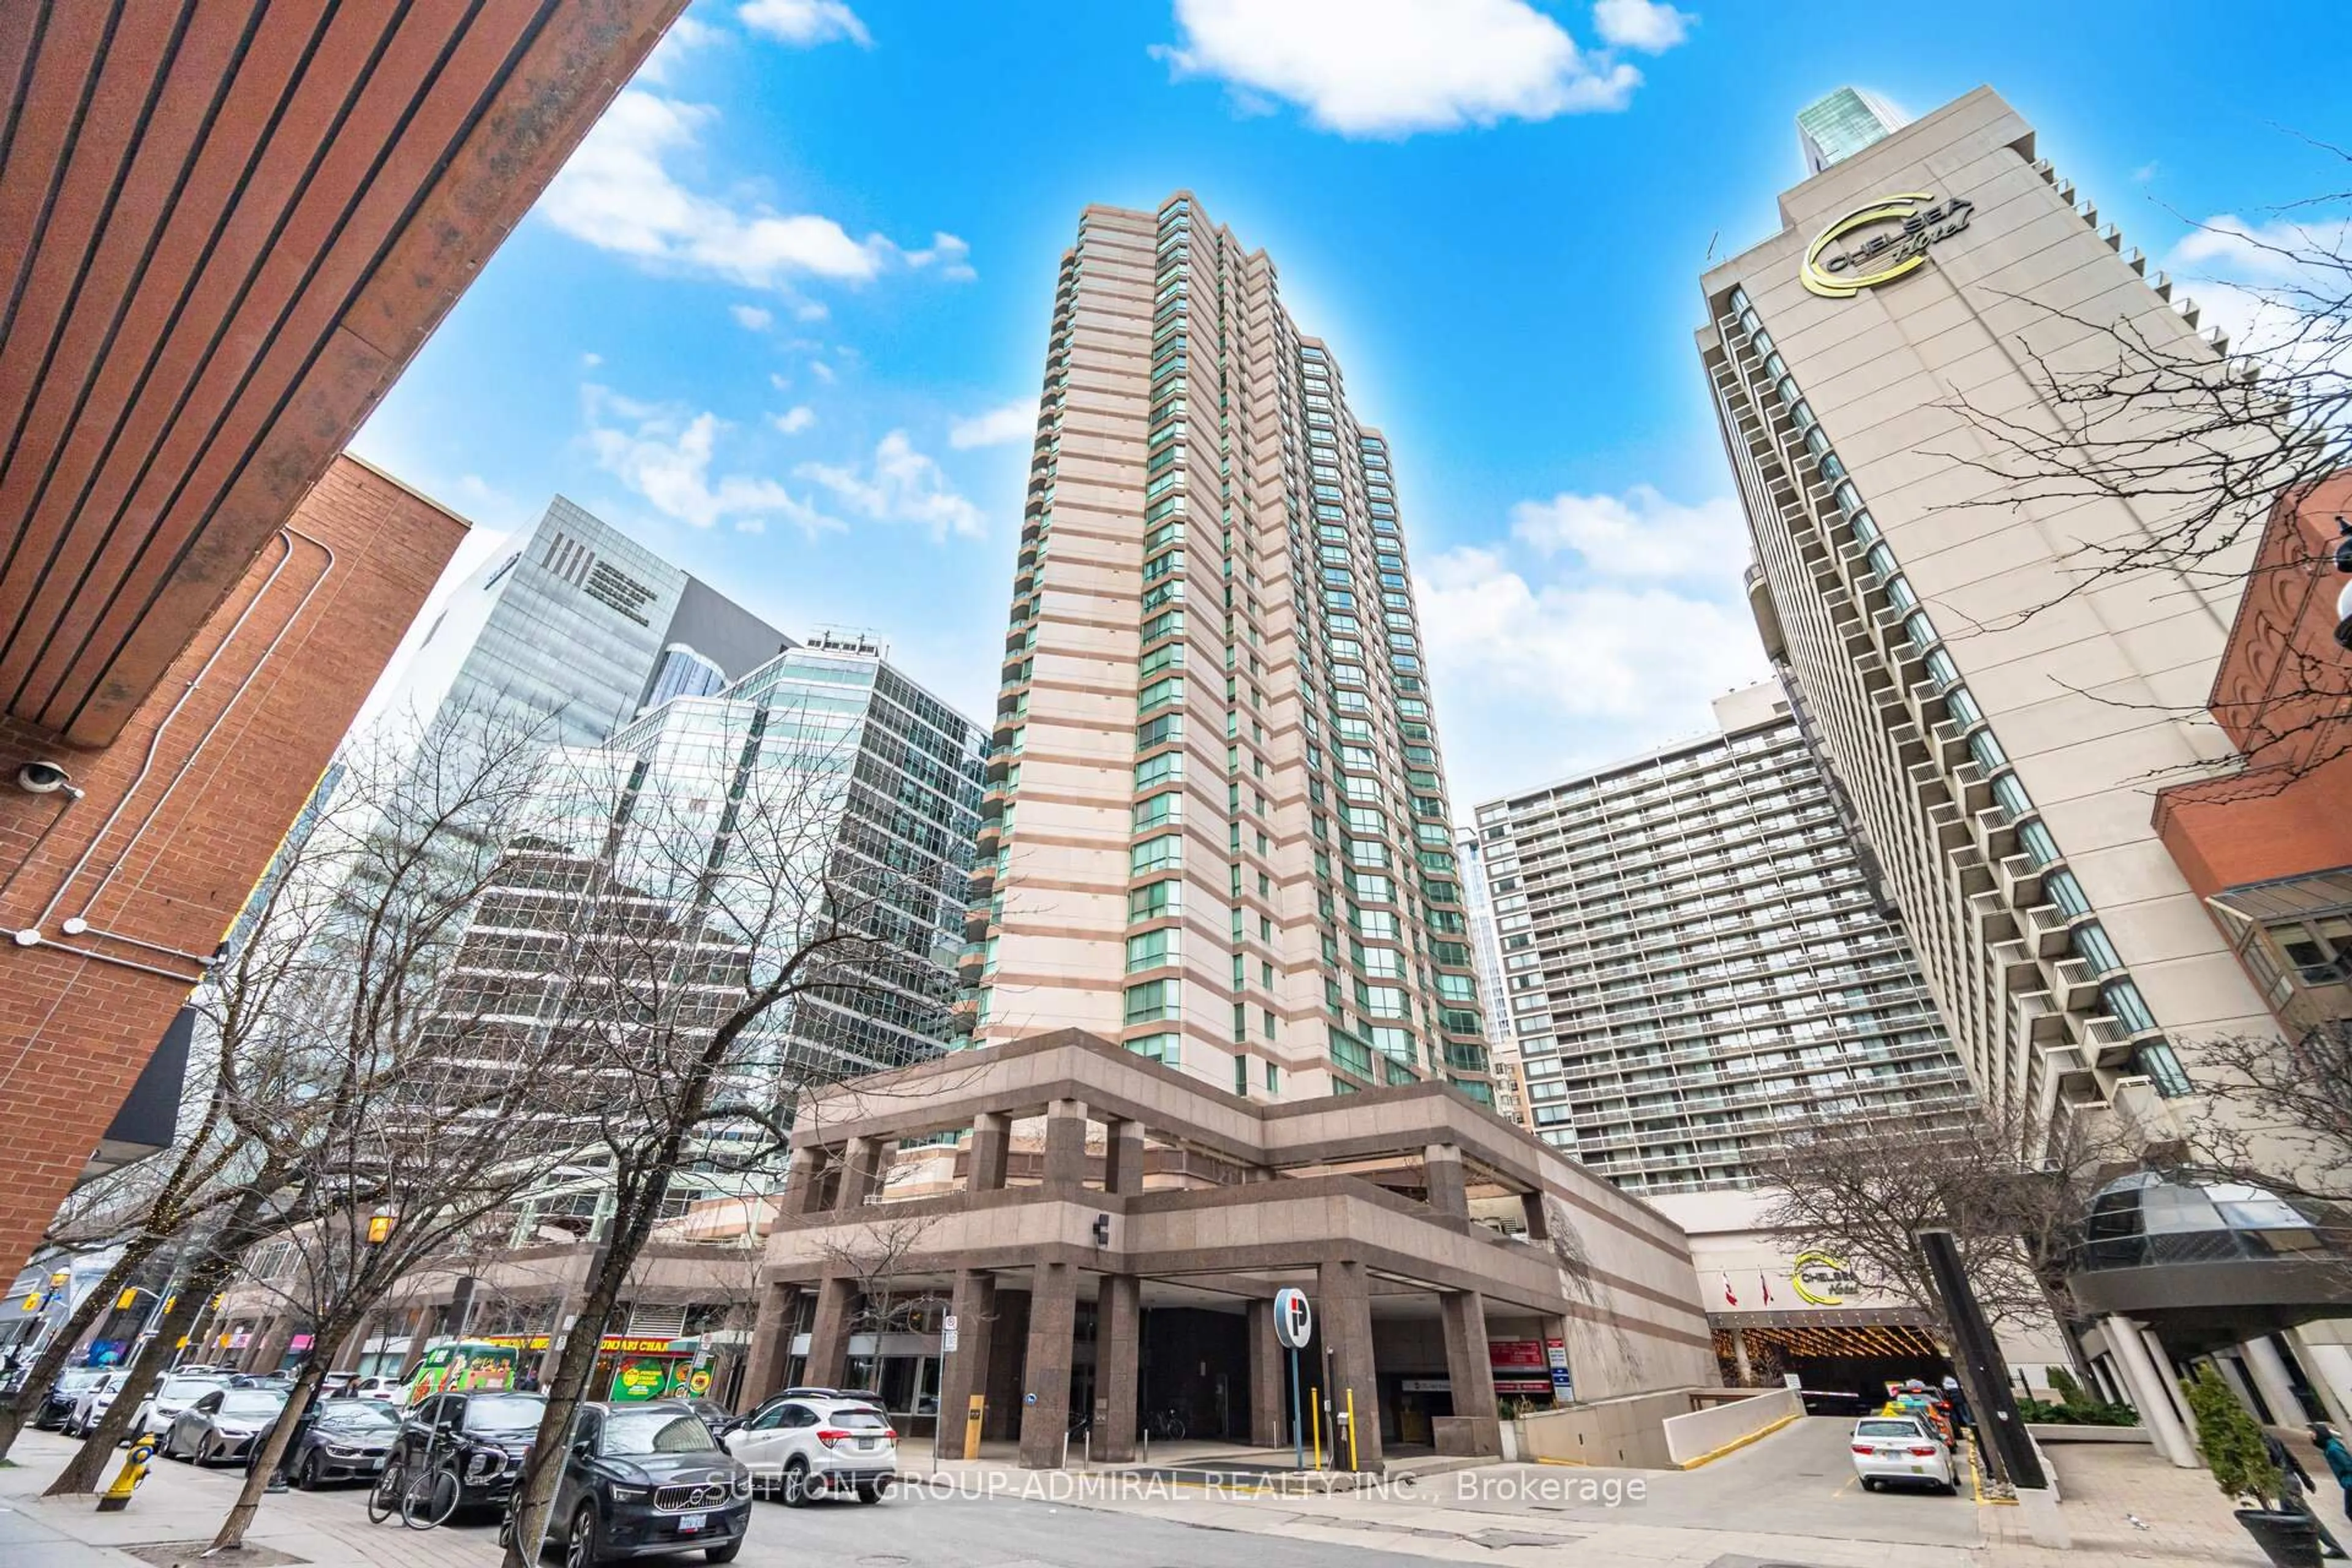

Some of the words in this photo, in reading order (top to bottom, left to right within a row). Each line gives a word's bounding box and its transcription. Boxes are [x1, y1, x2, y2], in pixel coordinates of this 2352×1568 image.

[1826, 197, 1972, 273] CHELSEA
[1893, 206, 1975, 262] Hotel
[601, 1340, 639, 1351] UNJABI
